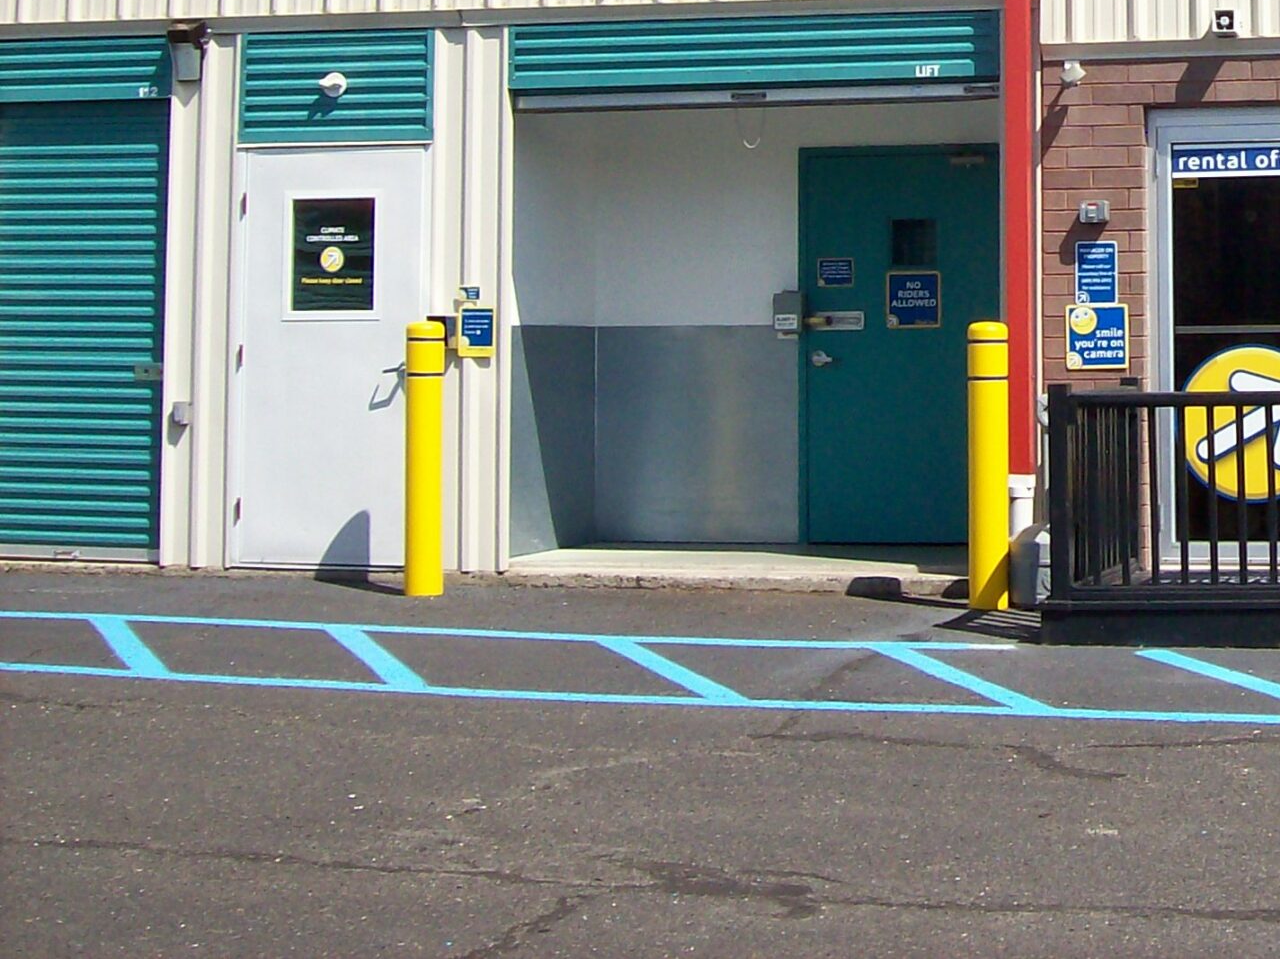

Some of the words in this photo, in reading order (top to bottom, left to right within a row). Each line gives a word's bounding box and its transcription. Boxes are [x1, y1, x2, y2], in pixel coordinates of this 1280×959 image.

[915, 65, 941, 77] LIFT
[1178, 151, 1247, 170] rental
[906, 281, 921, 289] NO
[897, 290, 930, 298] RIDERS
[891, 299, 936, 307] ALLOWED
[1095, 327, 1123, 337] smile
[1075, 338, 1108, 350] you're
[1084, 350, 1123, 358] camera
